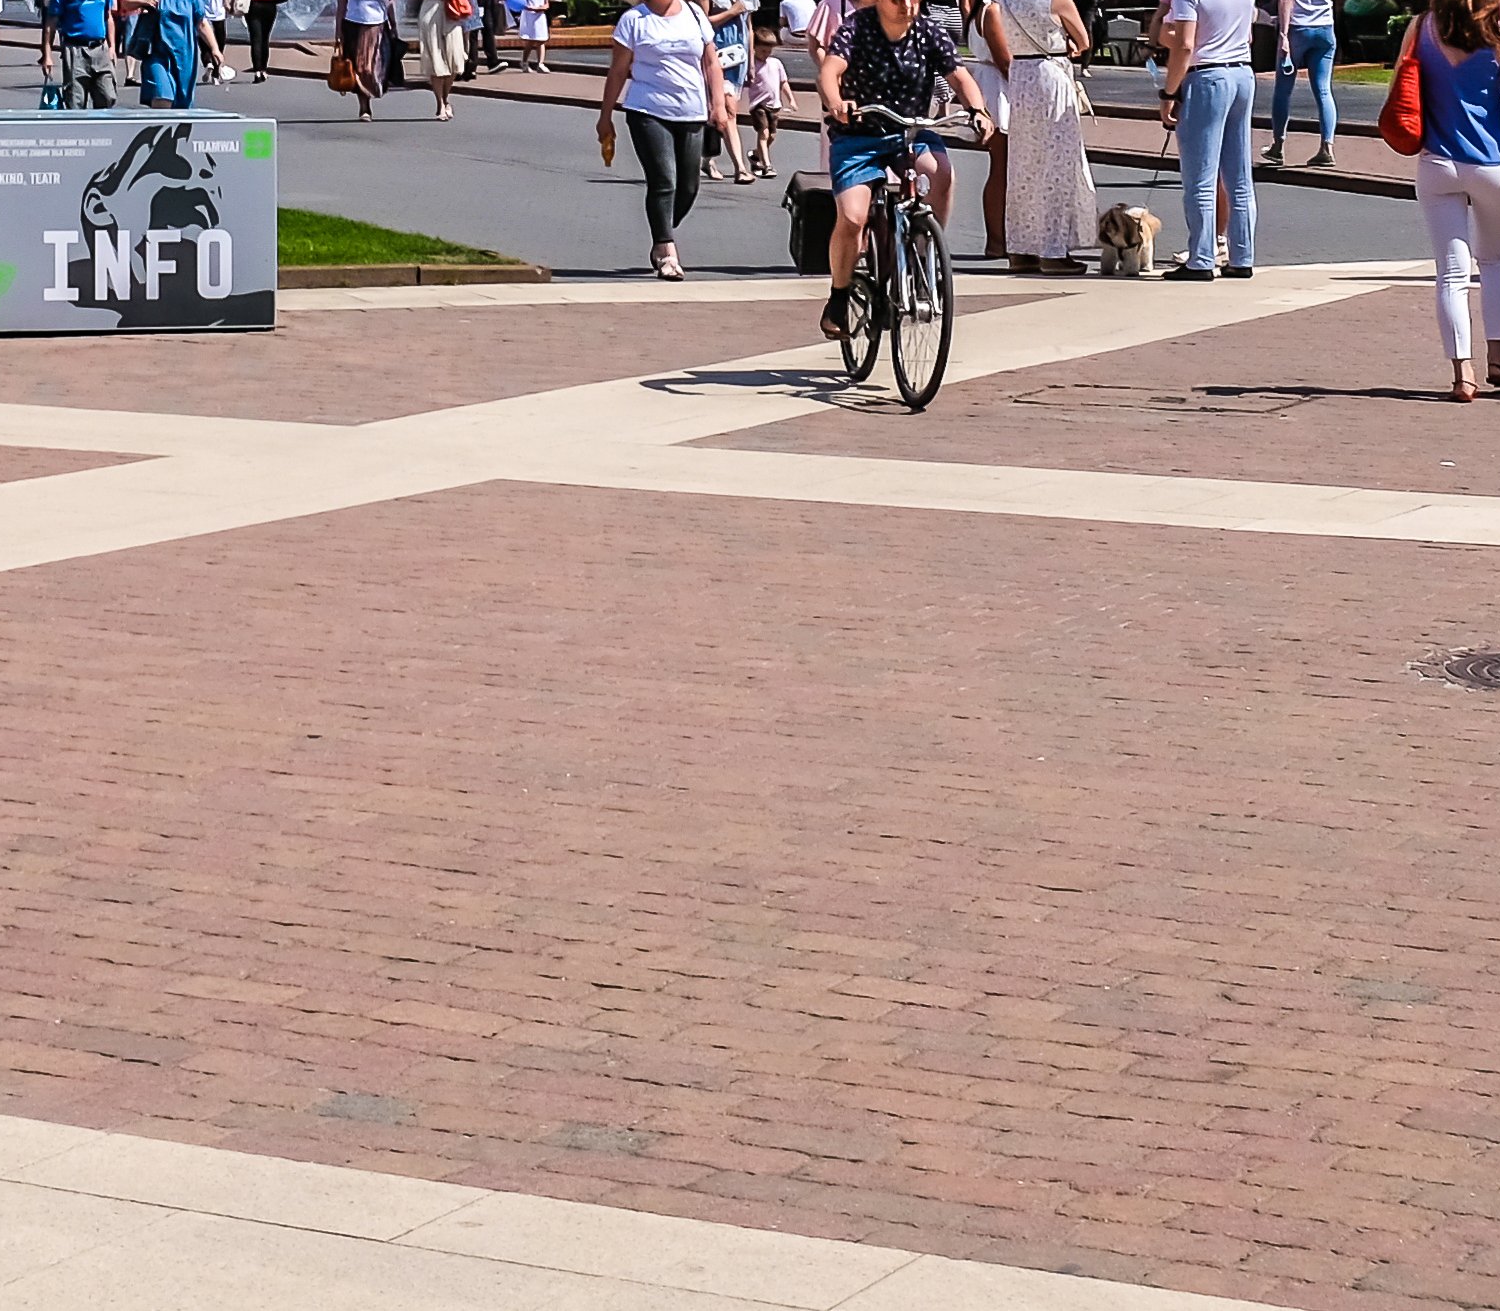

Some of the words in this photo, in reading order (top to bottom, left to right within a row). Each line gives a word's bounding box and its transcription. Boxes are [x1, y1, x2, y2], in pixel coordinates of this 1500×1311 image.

[193, 140, 241, 154] TRAMWAJ
[0, 173, 27, 186] KINO,
[30, 172, 61, 185] TEATR
[43, 229, 233, 302] INFO
